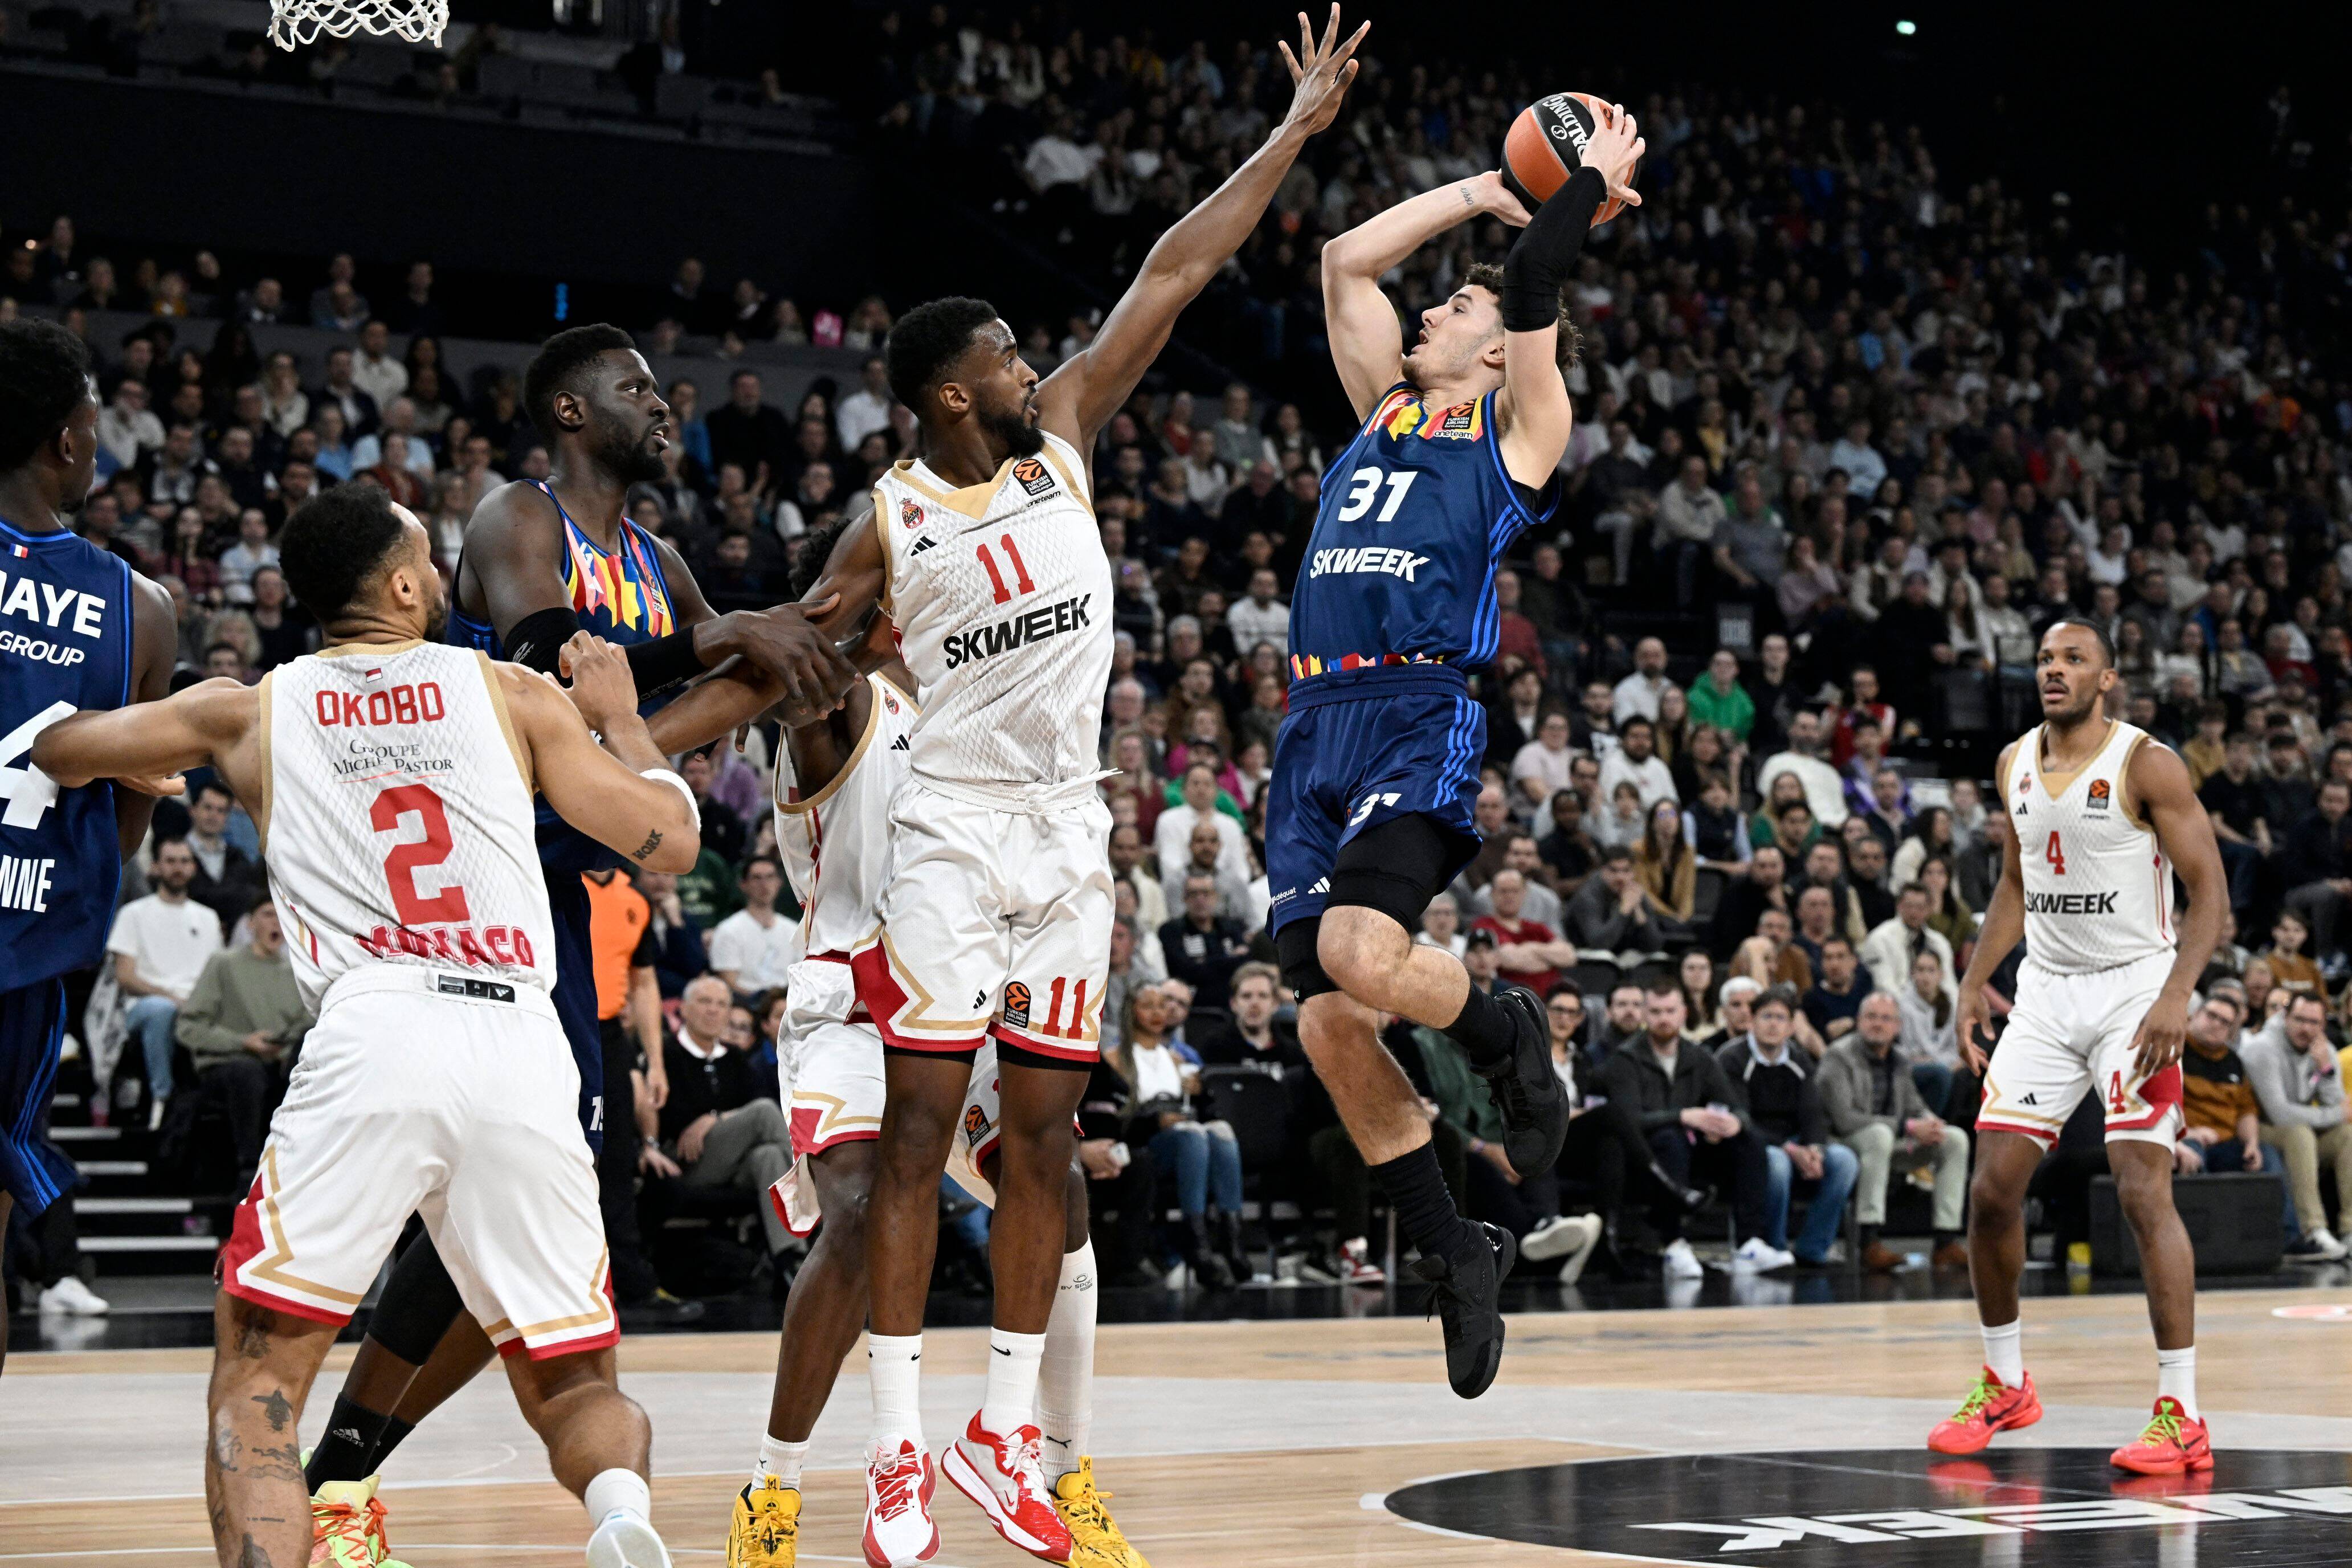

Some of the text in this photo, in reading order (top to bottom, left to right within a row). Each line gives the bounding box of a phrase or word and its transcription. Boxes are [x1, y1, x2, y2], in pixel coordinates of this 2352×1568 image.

[1542, 95, 1590, 160] ALDING
[1434, 430, 1473, 439] oneteam
[1026, 474, 1048, 488] TURKISH
[1028, 479, 1051, 491] AIRLINES
[1030, 483, 1053, 495] EuroLeague
[1337, 466, 1418, 522] 31
[1027, 491, 1061, 508] oneteam
[975, 533, 1035, 605] 11
[1310, 546, 1430, 583] SKWEEK
[0, 631, 85, 667] GROUP
[944, 593, 1092, 670] SKWEEK
[316, 681, 446, 728] OKOBO
[638, 676, 683, 703] OSTER
[332, 757, 454, 777] MICHE PASTOR
[369, 782, 471, 926] 2
[2045, 831, 2066, 875] 4
[1273, 887, 1297, 901] Adéquat
[1006, 1012, 1026, 1022] AIRLINES
[1007, 1007, 1027, 1018] TURKISH
[1042, 976, 1087, 1040] 11
[2110, 1070, 2125, 1114] 4
[590, 1096, 604, 1132] 1
[333, 1430, 365, 1447] adidas
